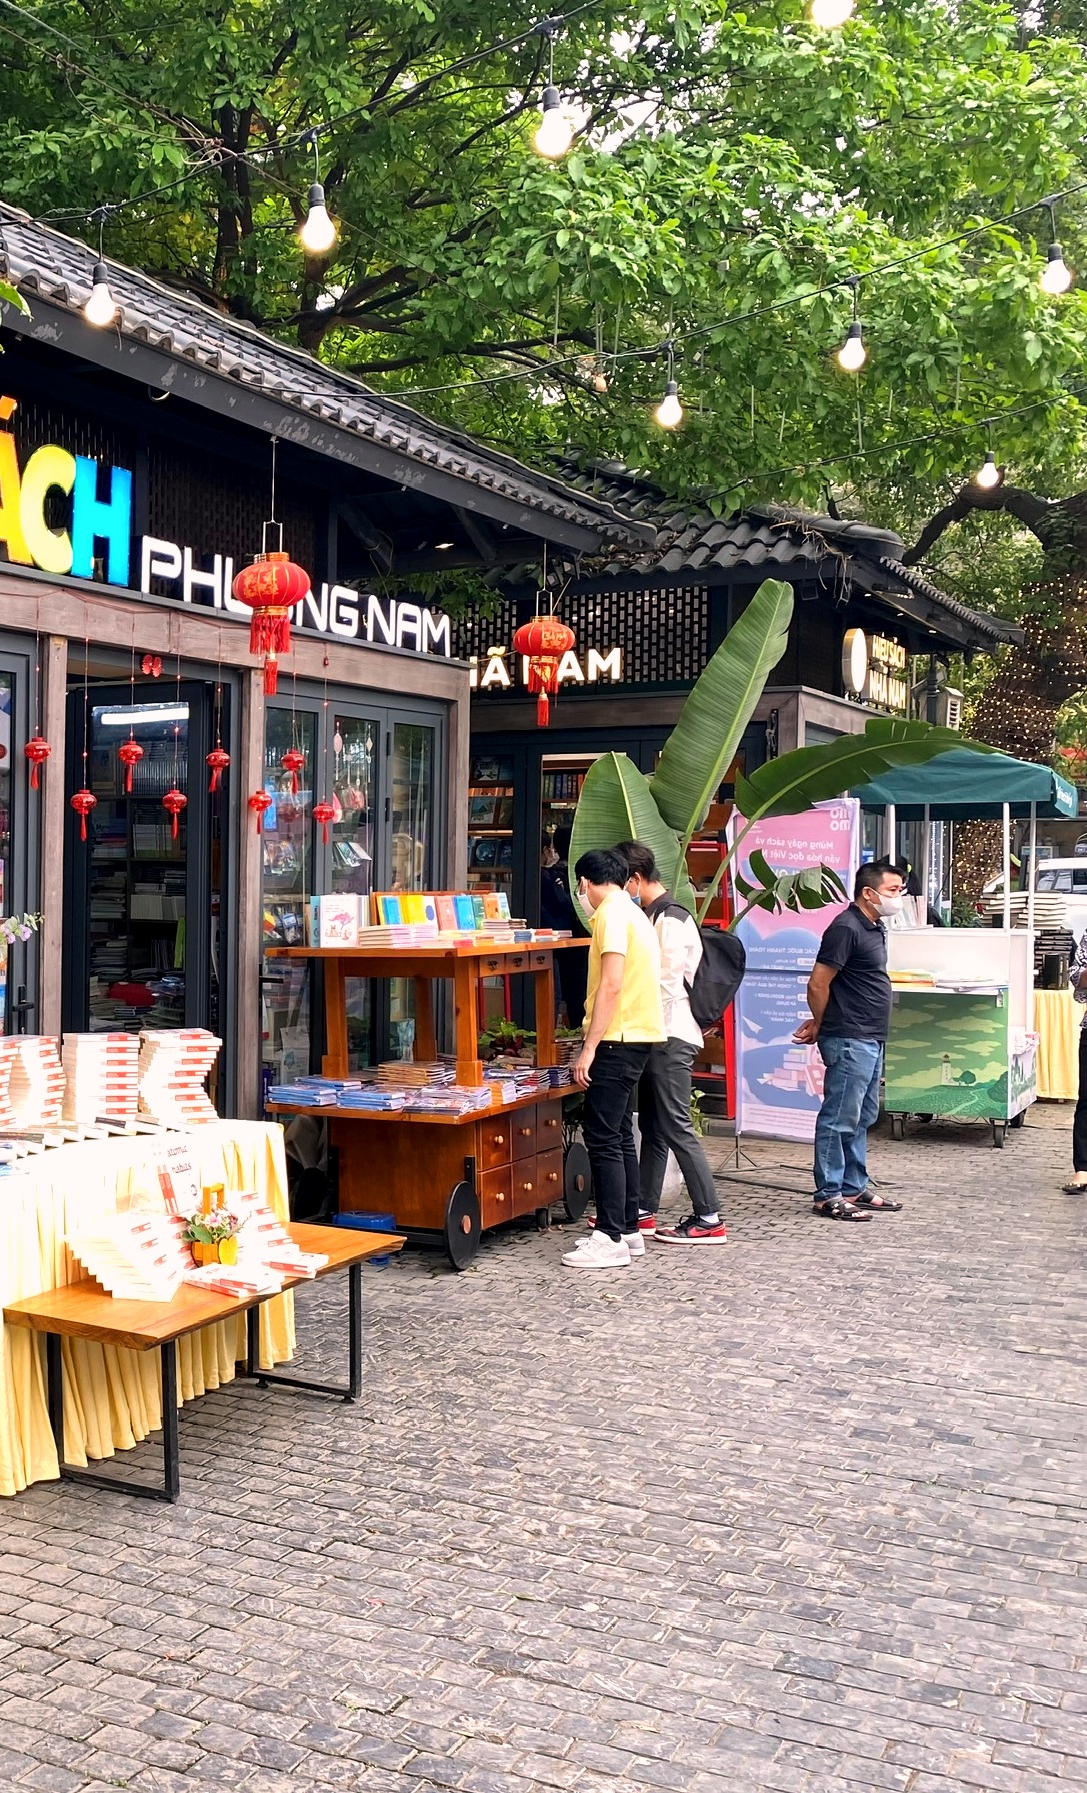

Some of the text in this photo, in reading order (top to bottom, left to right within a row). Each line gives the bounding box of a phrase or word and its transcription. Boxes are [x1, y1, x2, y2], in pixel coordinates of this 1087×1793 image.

[141, 535, 359, 638] PHNG
[367, 594, 451, 658] NAM
[523, 647, 621, 685] AM
[889, 677, 906, 709] NAM
